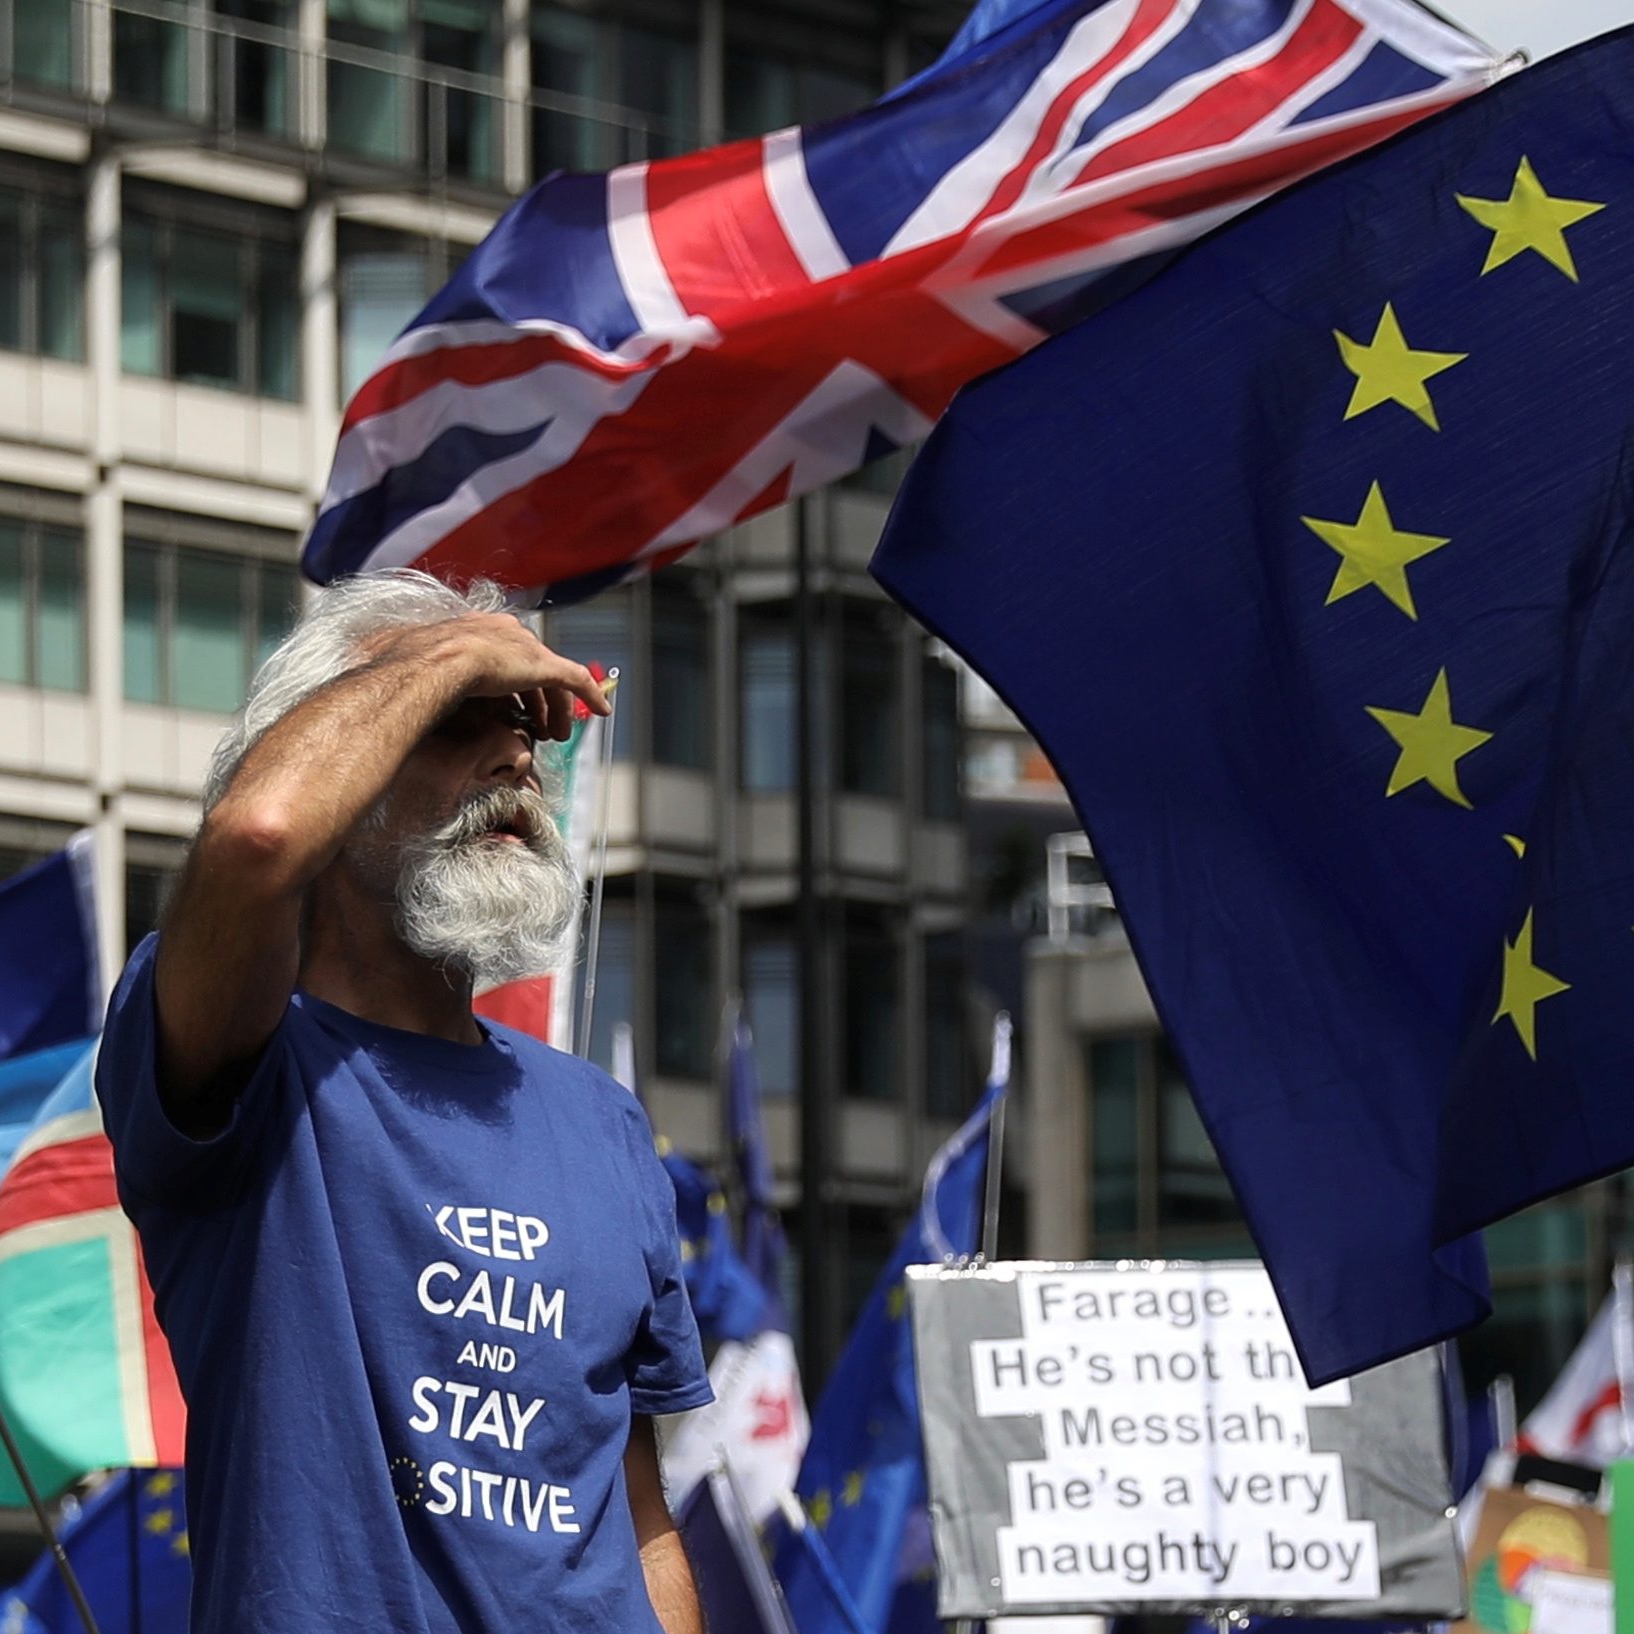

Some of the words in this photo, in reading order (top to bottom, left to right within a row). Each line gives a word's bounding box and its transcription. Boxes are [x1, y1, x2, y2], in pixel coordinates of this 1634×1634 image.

[426, 1203, 550, 1260] KEEP
[416, 1260, 566, 1340] CALM
[457, 1340, 516, 1373] AND
[990, 1346, 1116, 1389] He's
[1134, 1343, 1221, 1382] not
[1245, 1341, 1295, 1379] th
[408, 1376, 545, 1452] STAY
[1061, 1404, 1305, 1447] Messiah,
[391, 1456, 581, 1533] SITIVE
[1026, 1470, 1143, 1512] he's
[1163, 1472, 1191, 1505] a
[1213, 1471, 1328, 1515] very
[1017, 1531, 1238, 1584] naughty
[1266, 1532, 1363, 1583] boy
